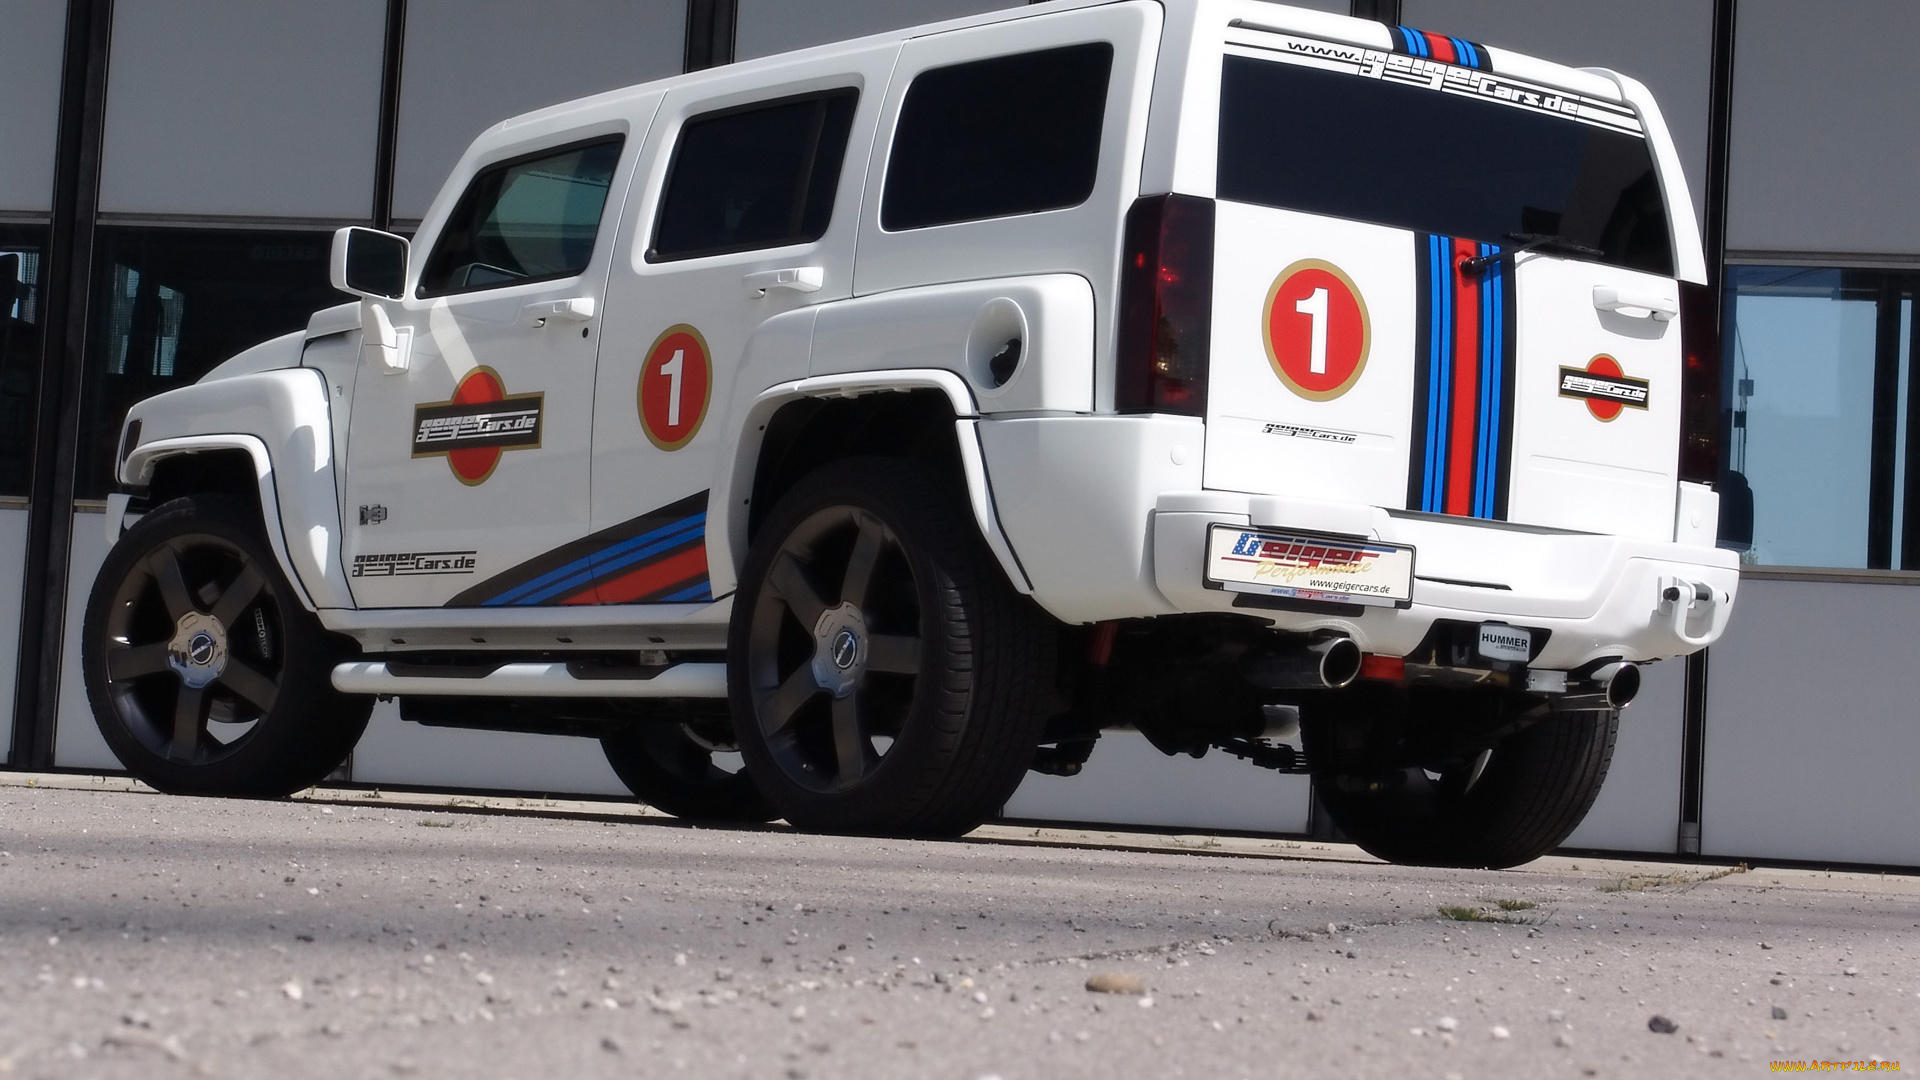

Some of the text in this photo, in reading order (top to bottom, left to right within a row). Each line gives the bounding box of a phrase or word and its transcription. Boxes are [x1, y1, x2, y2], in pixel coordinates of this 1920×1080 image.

[1295, 287, 1329, 375] 1
[660, 349, 684, 426] 1
[1253, 560, 1373, 583] Performance
[1309, 578, 1391, 594] www.geigercars.de
[1481, 633, 1528, 648] HUMMER
